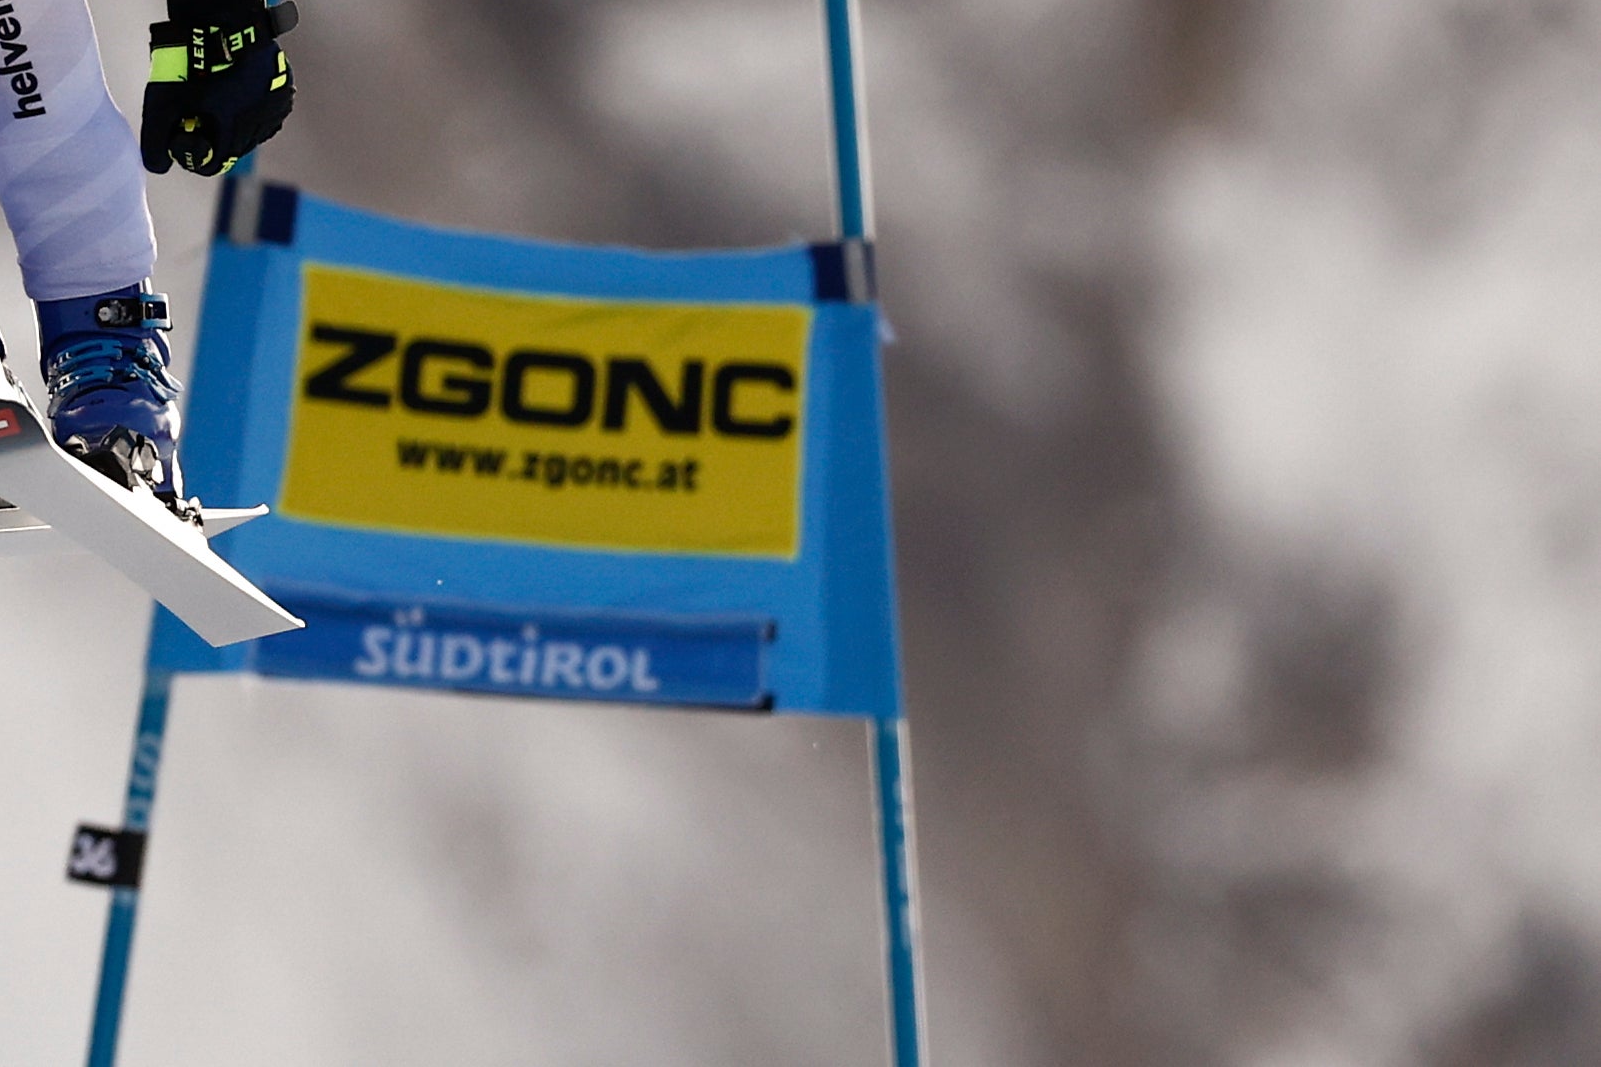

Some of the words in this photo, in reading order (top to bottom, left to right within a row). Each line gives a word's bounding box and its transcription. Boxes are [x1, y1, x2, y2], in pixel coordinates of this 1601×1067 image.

[192, 27, 204, 70] LEKI
[229, 25, 256, 52] LE
[304, 323, 795, 440] ZGONC
[396, 437, 700, 494] www.zgonc.at
